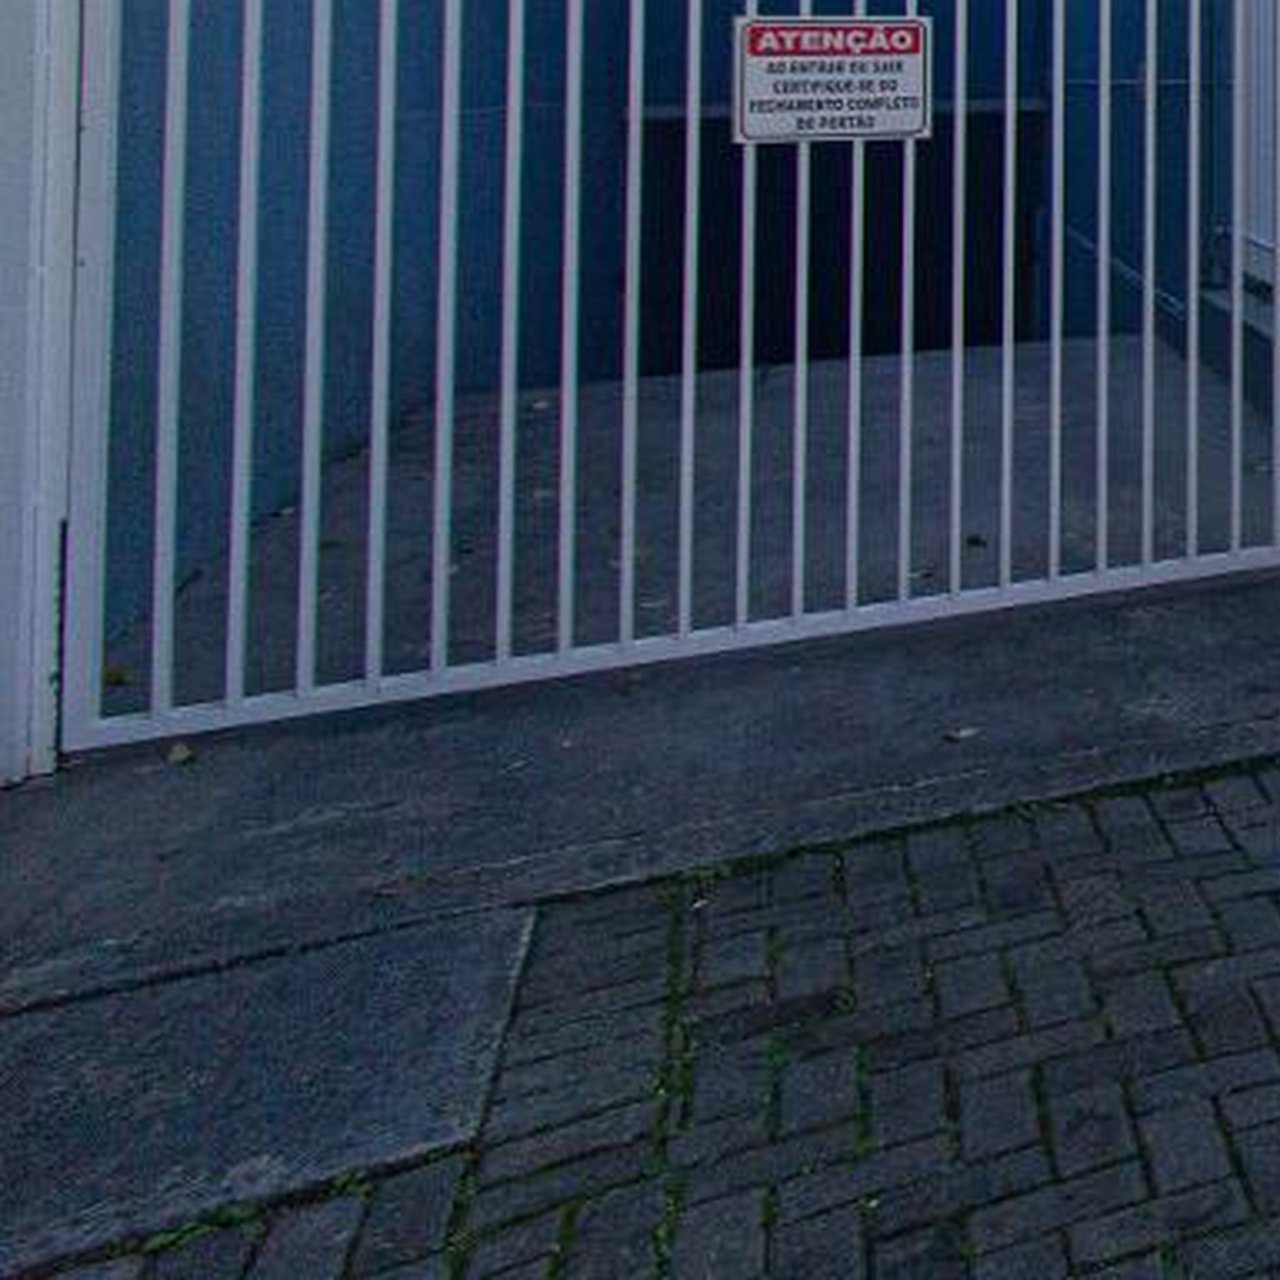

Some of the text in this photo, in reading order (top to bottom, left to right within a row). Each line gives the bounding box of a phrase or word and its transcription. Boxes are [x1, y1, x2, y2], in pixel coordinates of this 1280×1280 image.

[757, 27, 913, 53] ATENÇÃO
[790, 60, 846, 74] ENTRAR
[870, 61, 904, 74] SAIR
[749, 96, 920, 114] FECHAMENTO COMPLETO
